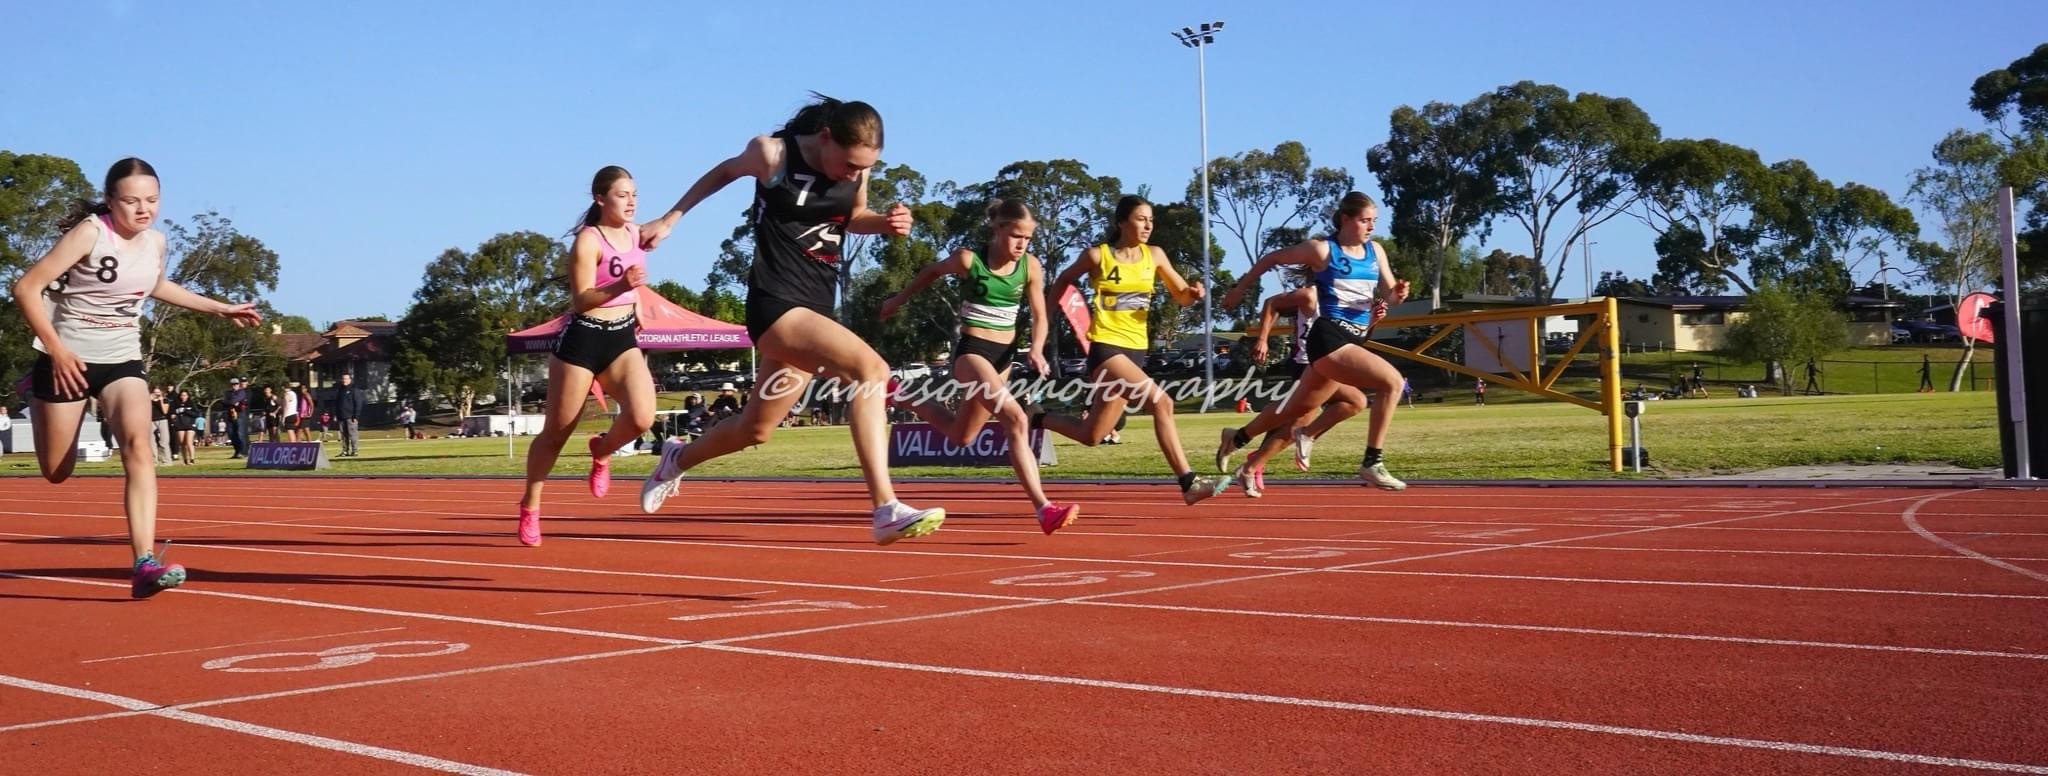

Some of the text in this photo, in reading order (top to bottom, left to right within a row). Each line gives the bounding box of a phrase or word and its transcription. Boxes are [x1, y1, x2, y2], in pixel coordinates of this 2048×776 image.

[793, 173, 816, 206] 7
[96, 255, 118, 283] 8
[608, 255, 624, 278] 6
[1106, 265, 1122, 285] 4
[1337, 257, 1352, 275] 3
[975, 274, 989, 297] 5
[672, 333, 708, 343] ATHLETIC
[710, 333, 741, 343] LEAGUE
[896, 428, 1038, 457] VAL.ORG.
[251, 446, 317, 465] VAL.ORG.AU
[201, 640, 471, 673] 8
